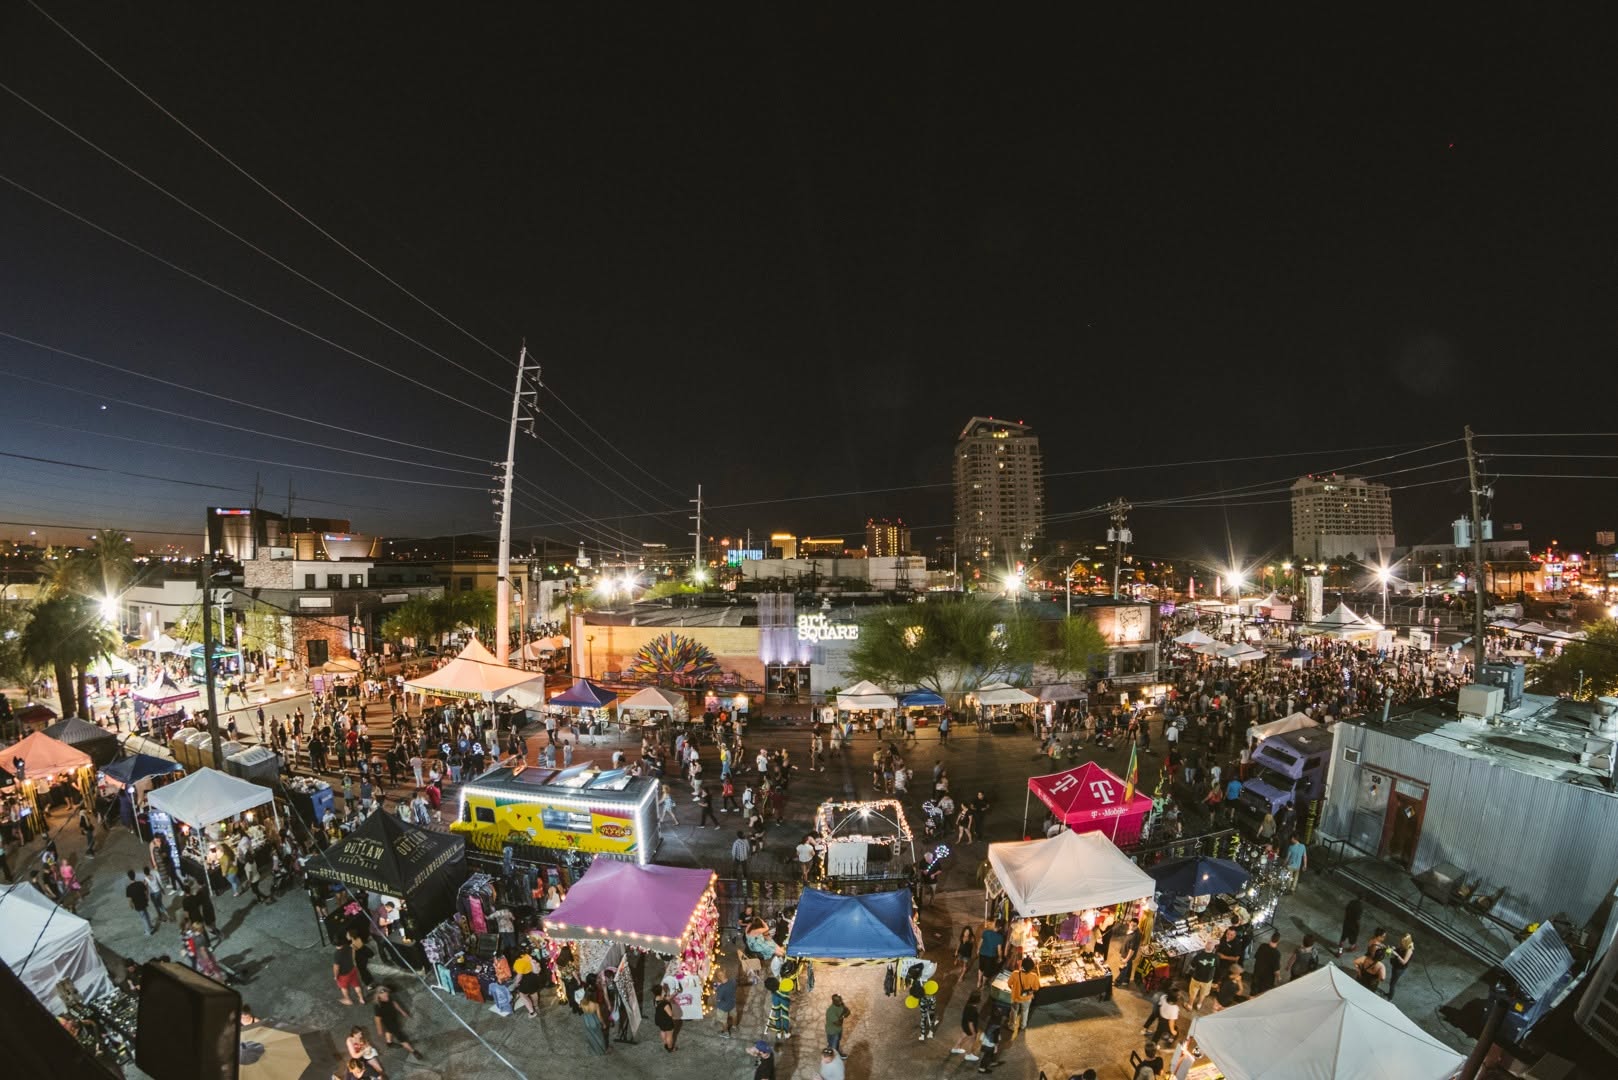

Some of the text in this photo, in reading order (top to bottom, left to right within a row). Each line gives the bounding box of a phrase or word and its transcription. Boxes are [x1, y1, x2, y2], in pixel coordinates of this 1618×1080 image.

[798, 612, 828, 627] art
[798, 625, 859, 643] SQUARE
[1090, 780, 1115, 805] T
[344, 842, 385, 860] OUTLAW
